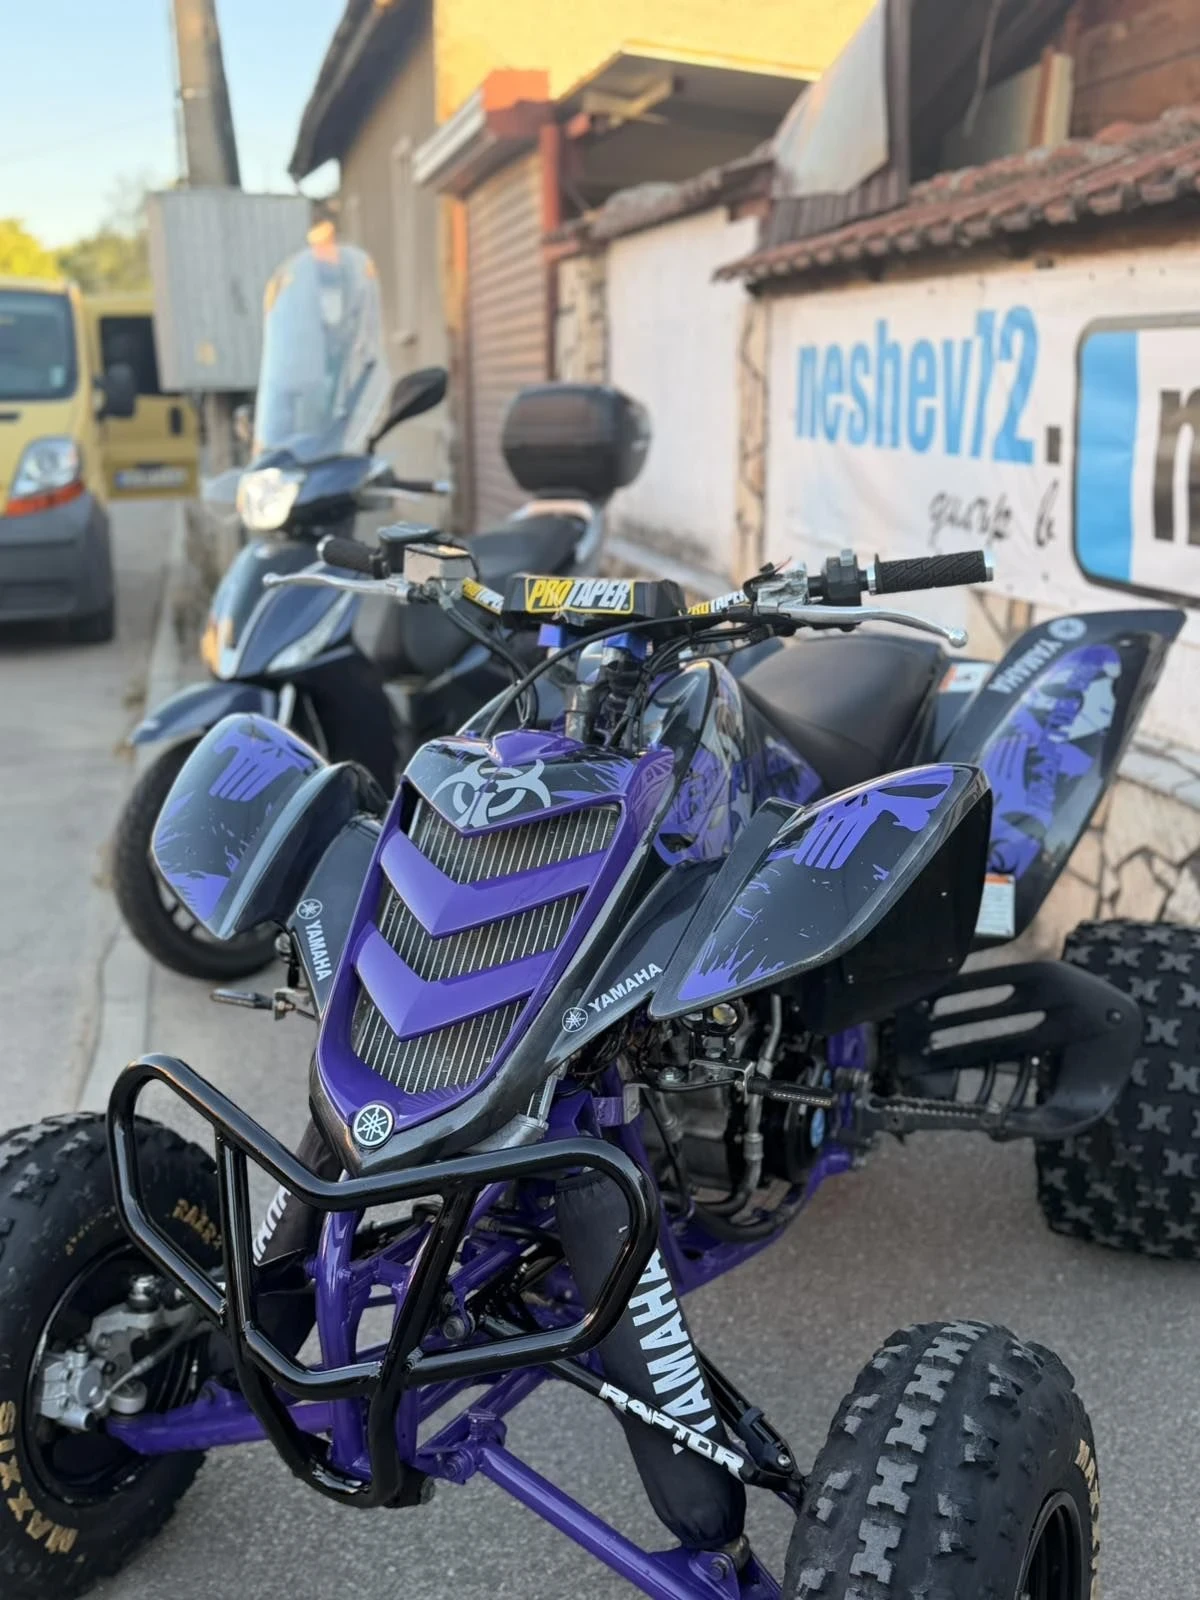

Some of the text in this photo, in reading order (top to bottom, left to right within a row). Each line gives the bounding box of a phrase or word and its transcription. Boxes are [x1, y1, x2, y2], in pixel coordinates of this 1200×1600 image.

[989, 638, 1064, 695] YAMAHA
[304, 919, 332, 982] YAMAHA
[587, 962, 663, 1014] YAMAHA
